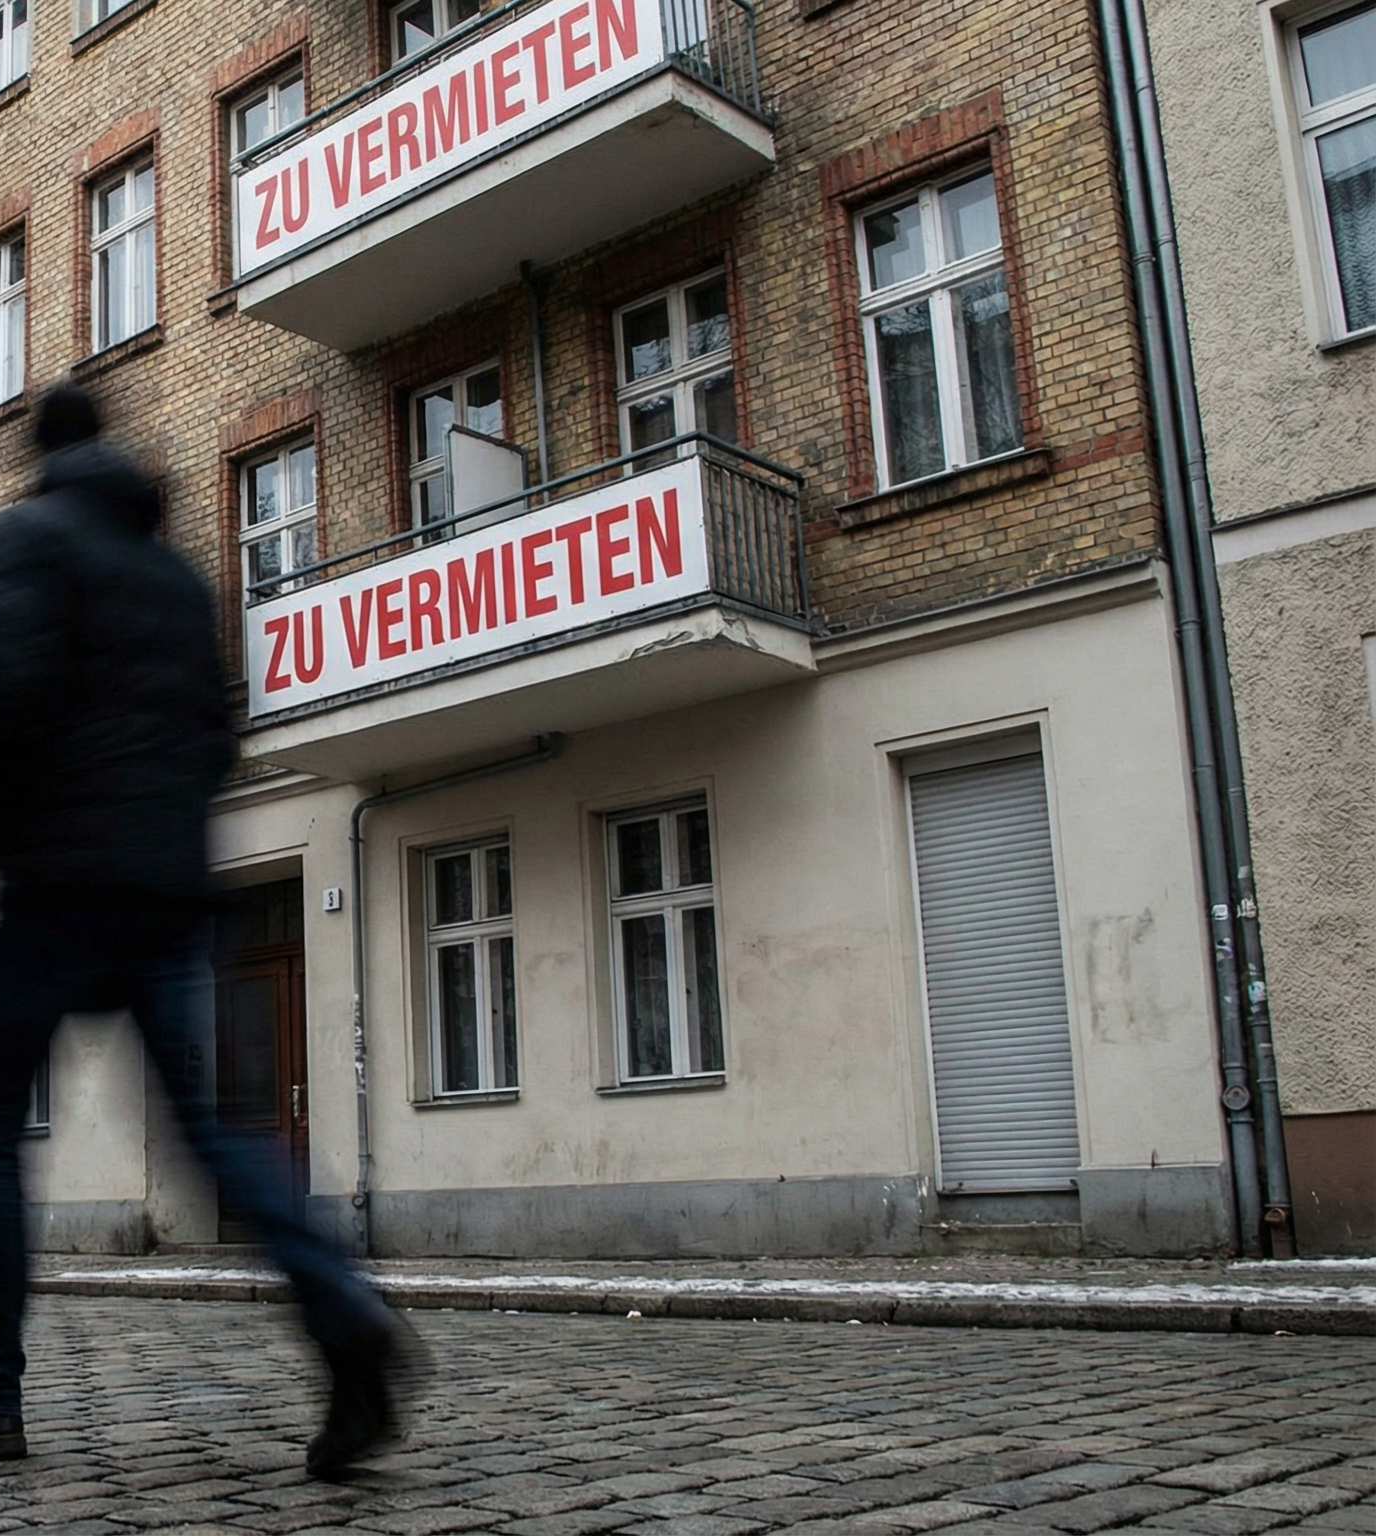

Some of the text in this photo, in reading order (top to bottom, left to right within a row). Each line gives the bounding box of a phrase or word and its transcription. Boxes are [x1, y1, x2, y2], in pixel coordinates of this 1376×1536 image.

[254, 0, 639, 250] ZU VERMIETEN
[264, 488, 683, 694] ZU VERMIETEN
